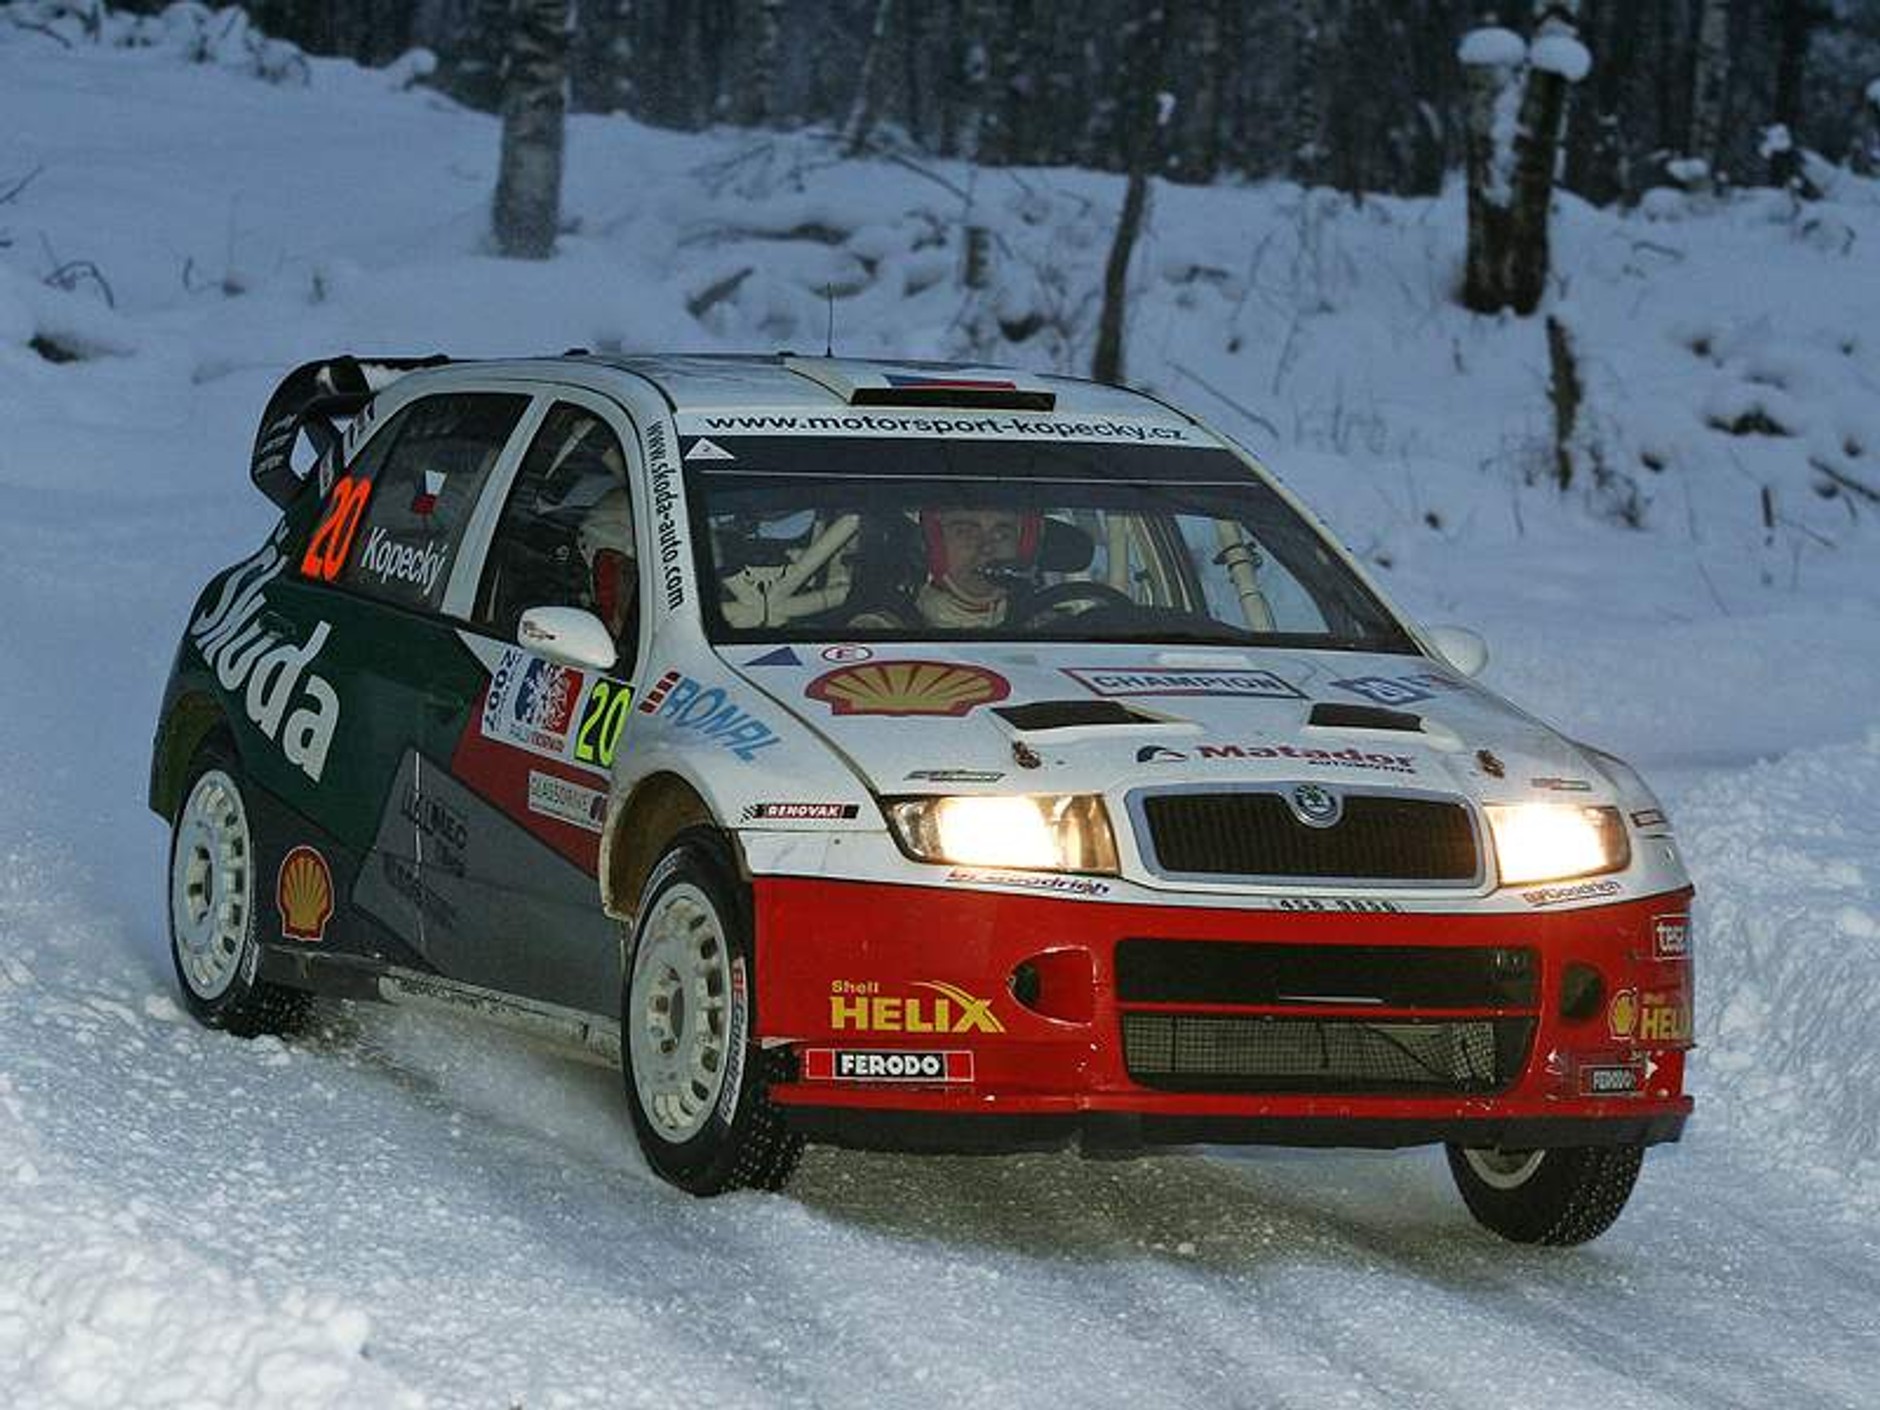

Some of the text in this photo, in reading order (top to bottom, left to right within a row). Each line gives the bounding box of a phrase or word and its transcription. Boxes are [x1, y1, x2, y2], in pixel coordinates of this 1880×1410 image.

[706, 414, 1188, 441] www.motorsport-kopecky.cz
[301, 474, 372, 583] 20
[647, 420, 684, 611] www.skoda-auto.com
[360, 526, 449, 596] Kopecký
[1097, 673, 1285, 693] CHAMPION
[575, 681, 632, 768] 20
[654, 677, 781, 764] RONAL
[1198, 745, 1414, 768] Matador
[830, 981, 1006, 1034] HELIX
[831, 980, 880, 995] Shell
[840, 1054, 941, 1077] FERODO
